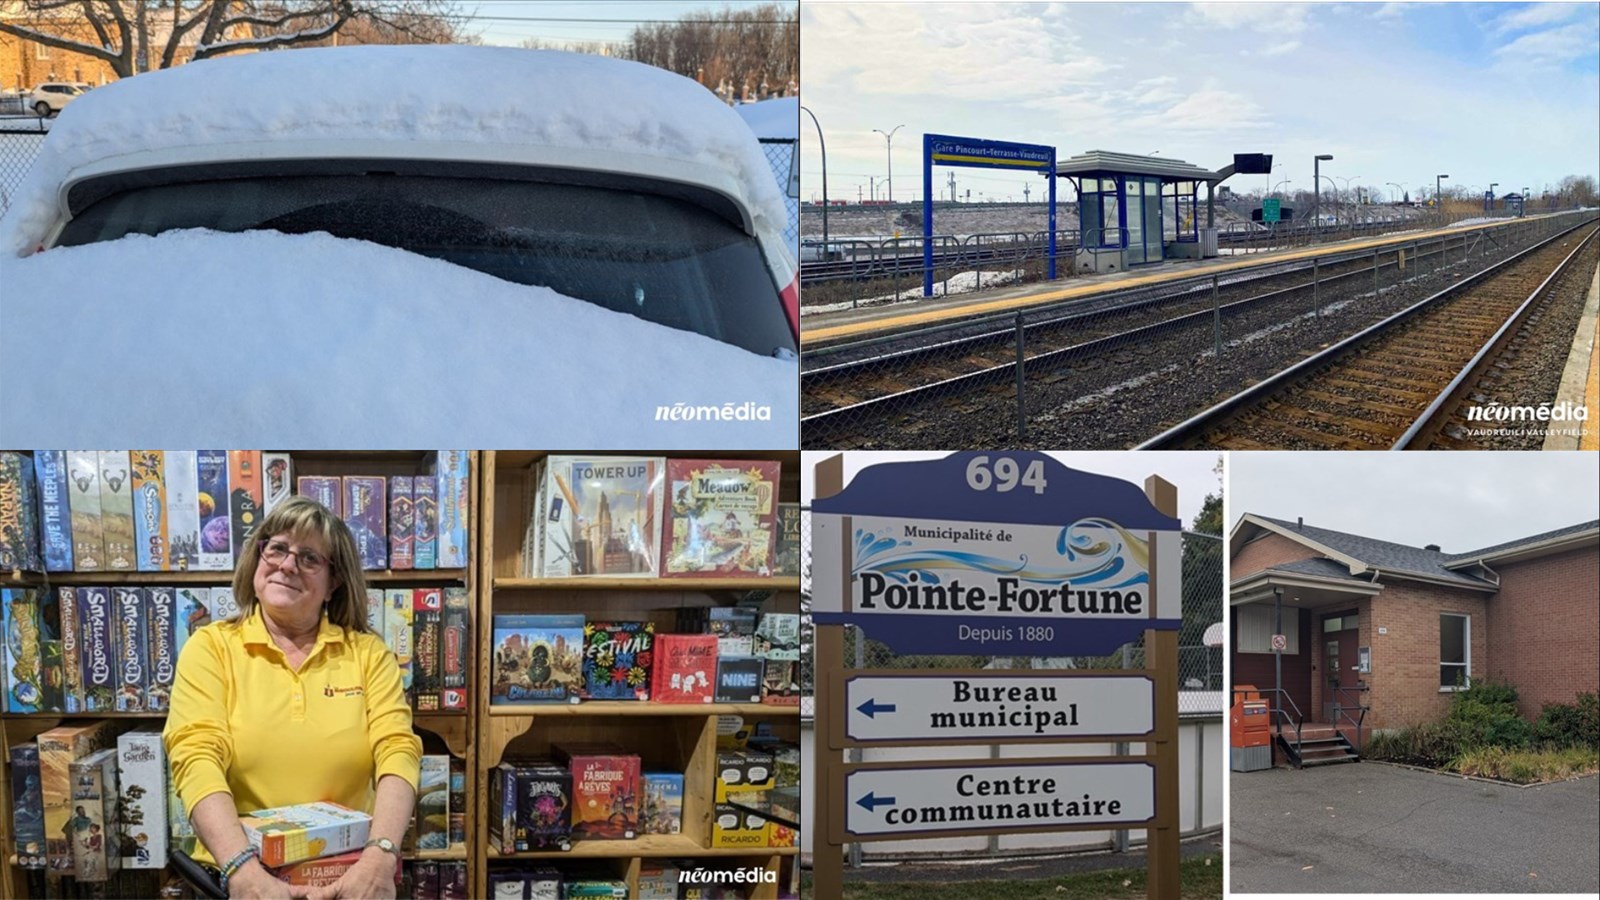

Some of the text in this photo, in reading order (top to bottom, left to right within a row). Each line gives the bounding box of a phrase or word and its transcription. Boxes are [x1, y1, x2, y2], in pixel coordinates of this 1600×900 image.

[936, 143, 953, 153] Gare
[576, 465, 647, 480] TOWER UP
[965, 456, 1048, 495] 694
[698, 478, 752, 494] Meadow
[43, 460, 66, 549] SAVE THE MEEPLES
[145, 486, 158, 532] Seasons
[904, 525, 1013, 544] Municipalité de
[860, 571, 1143, 615] Pointe-Fortune
[87, 591, 110, 684] SMALLWORLD
[120, 592, 142, 684] SMALLWORLD
[152, 591, 174, 684] SMALLWORLD
[958, 625, 1054, 643] Depuis 1880
[721, 673, 758, 687] NINE
[953, 680, 1058, 703] Bureau
[930, 703, 1079, 733] municipal
[583, 771, 624, 781] FABRIQUE
[956, 774, 1056, 797] Centre
[885, 794, 1121, 825] communautaire
[720, 835, 762, 843] RICARDO
[302, 867, 311, 877] LA
